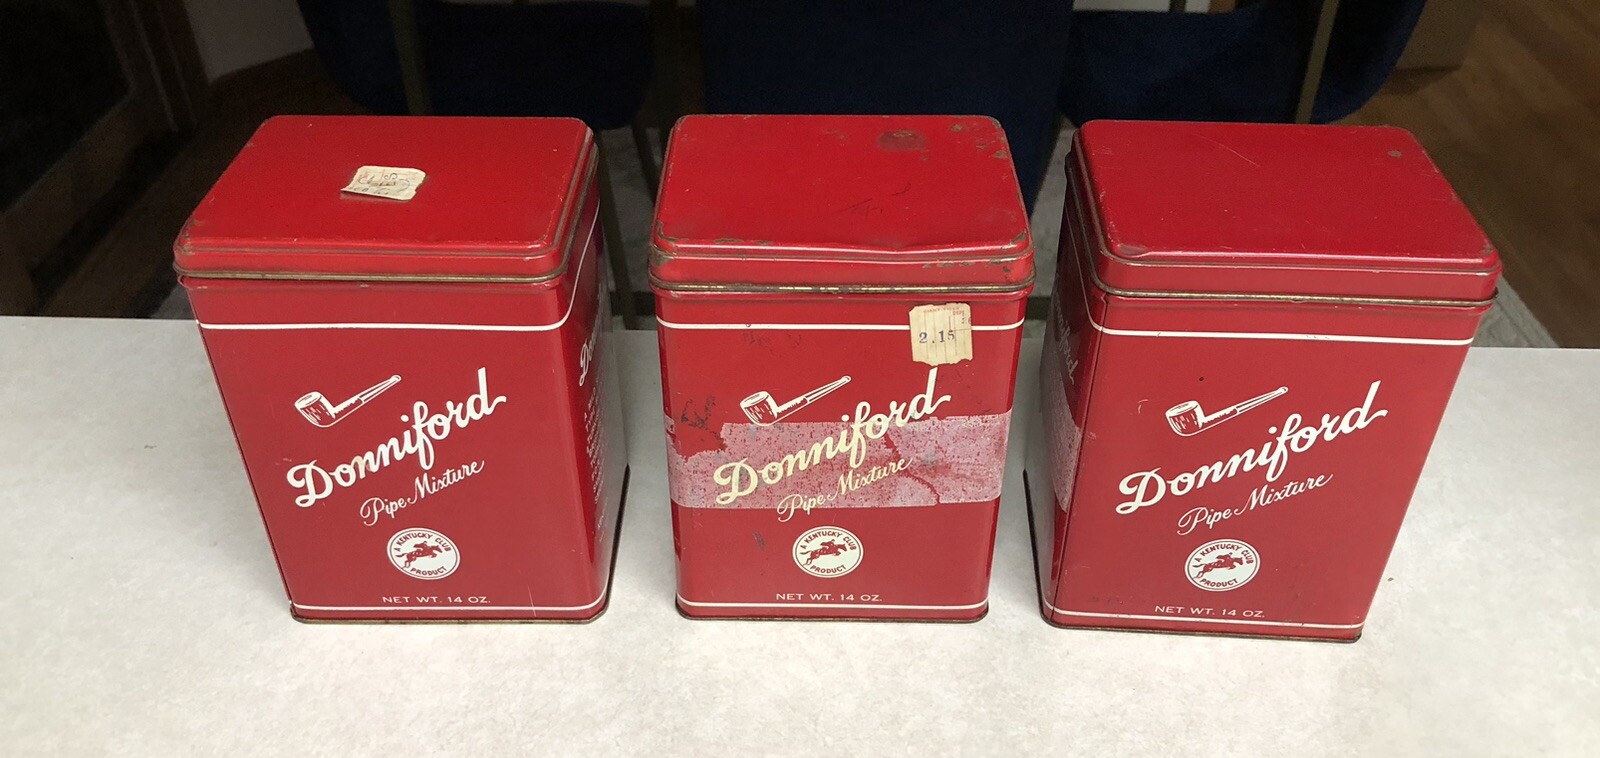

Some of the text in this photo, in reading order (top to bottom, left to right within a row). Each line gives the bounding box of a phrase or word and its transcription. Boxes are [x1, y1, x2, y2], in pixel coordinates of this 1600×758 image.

[918, 329, 956, 344] 2.15
[286, 366, 507, 508] Donniford
[713, 367, 952, 505] Donniford
[1115, 380, 1389, 515] Donniford
[359, 460, 486, 527] Pipe Mixture
[776, 457, 914, 523] Pipe Mixture
[1176, 474, 1334, 536] Pipe Mixture
[397, 532, 432, 545] KENTUCKY
[435, 538, 452, 552] CLUB
[805, 531, 842, 544] KENTUCKY
[843, 537, 857, 550] CLUB
[1201, 544, 1242, 557] KENTUCKY
[1242, 549, 1254, 564] CLUB
[411, 566, 447, 576] PRODUCT
[810, 564, 846, 573] PRODUCT
[1200, 577, 1238, 588] PRODUCT
[467, 596, 491, 604] OZ.
[776, 593, 883, 602] NET WT. 14 OZ.
[1154, 605, 1265, 618] NET WT. 14 OZ.
